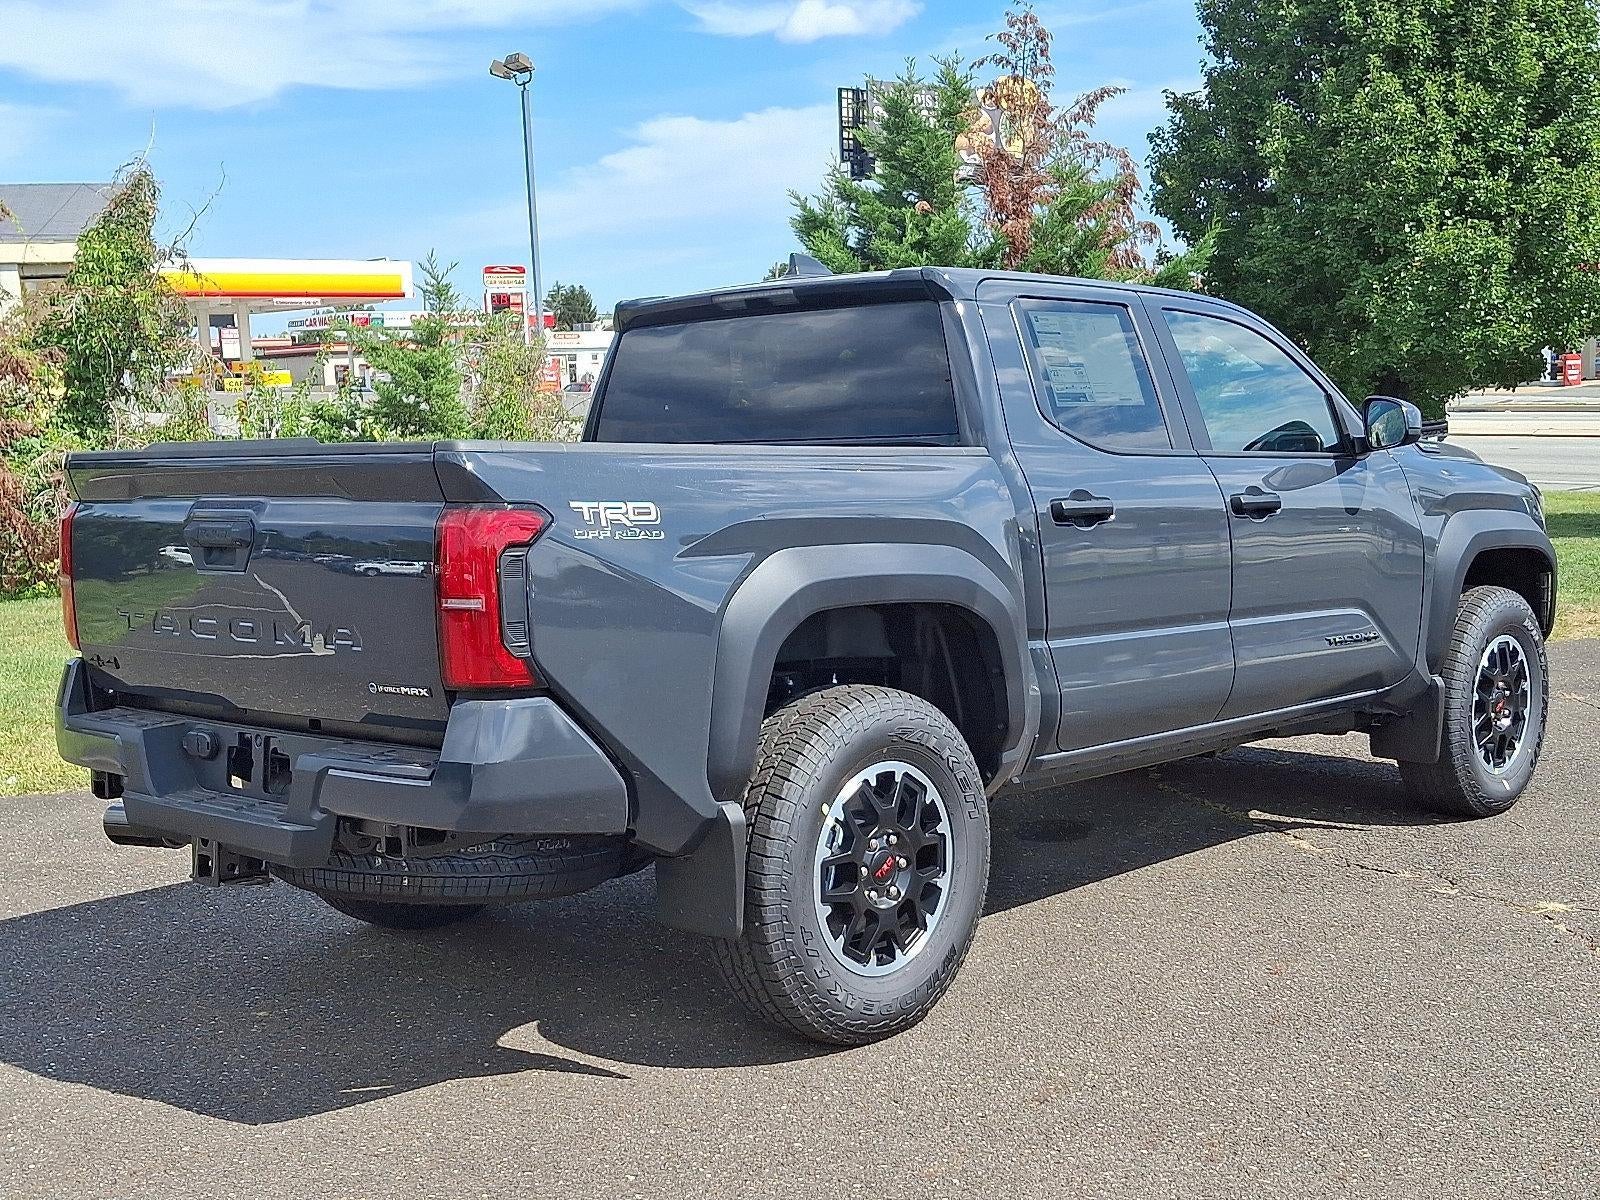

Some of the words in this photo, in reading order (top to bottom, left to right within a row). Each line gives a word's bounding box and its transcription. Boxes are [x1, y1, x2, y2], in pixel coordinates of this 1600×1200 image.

[568, 500, 661, 530] TRD
[573, 528, 611, 540] OFF
[613, 528, 665, 540] ROAD
[117, 608, 363, 652] TACOMA
[1325, 631, 1380, 646] TACOMA
[400, 686, 430, 697] MAX
[887, 726, 980, 820] FALKEN
[874, 855, 894, 879] TRD
[826, 942, 959, 1017] WILDPEAK
